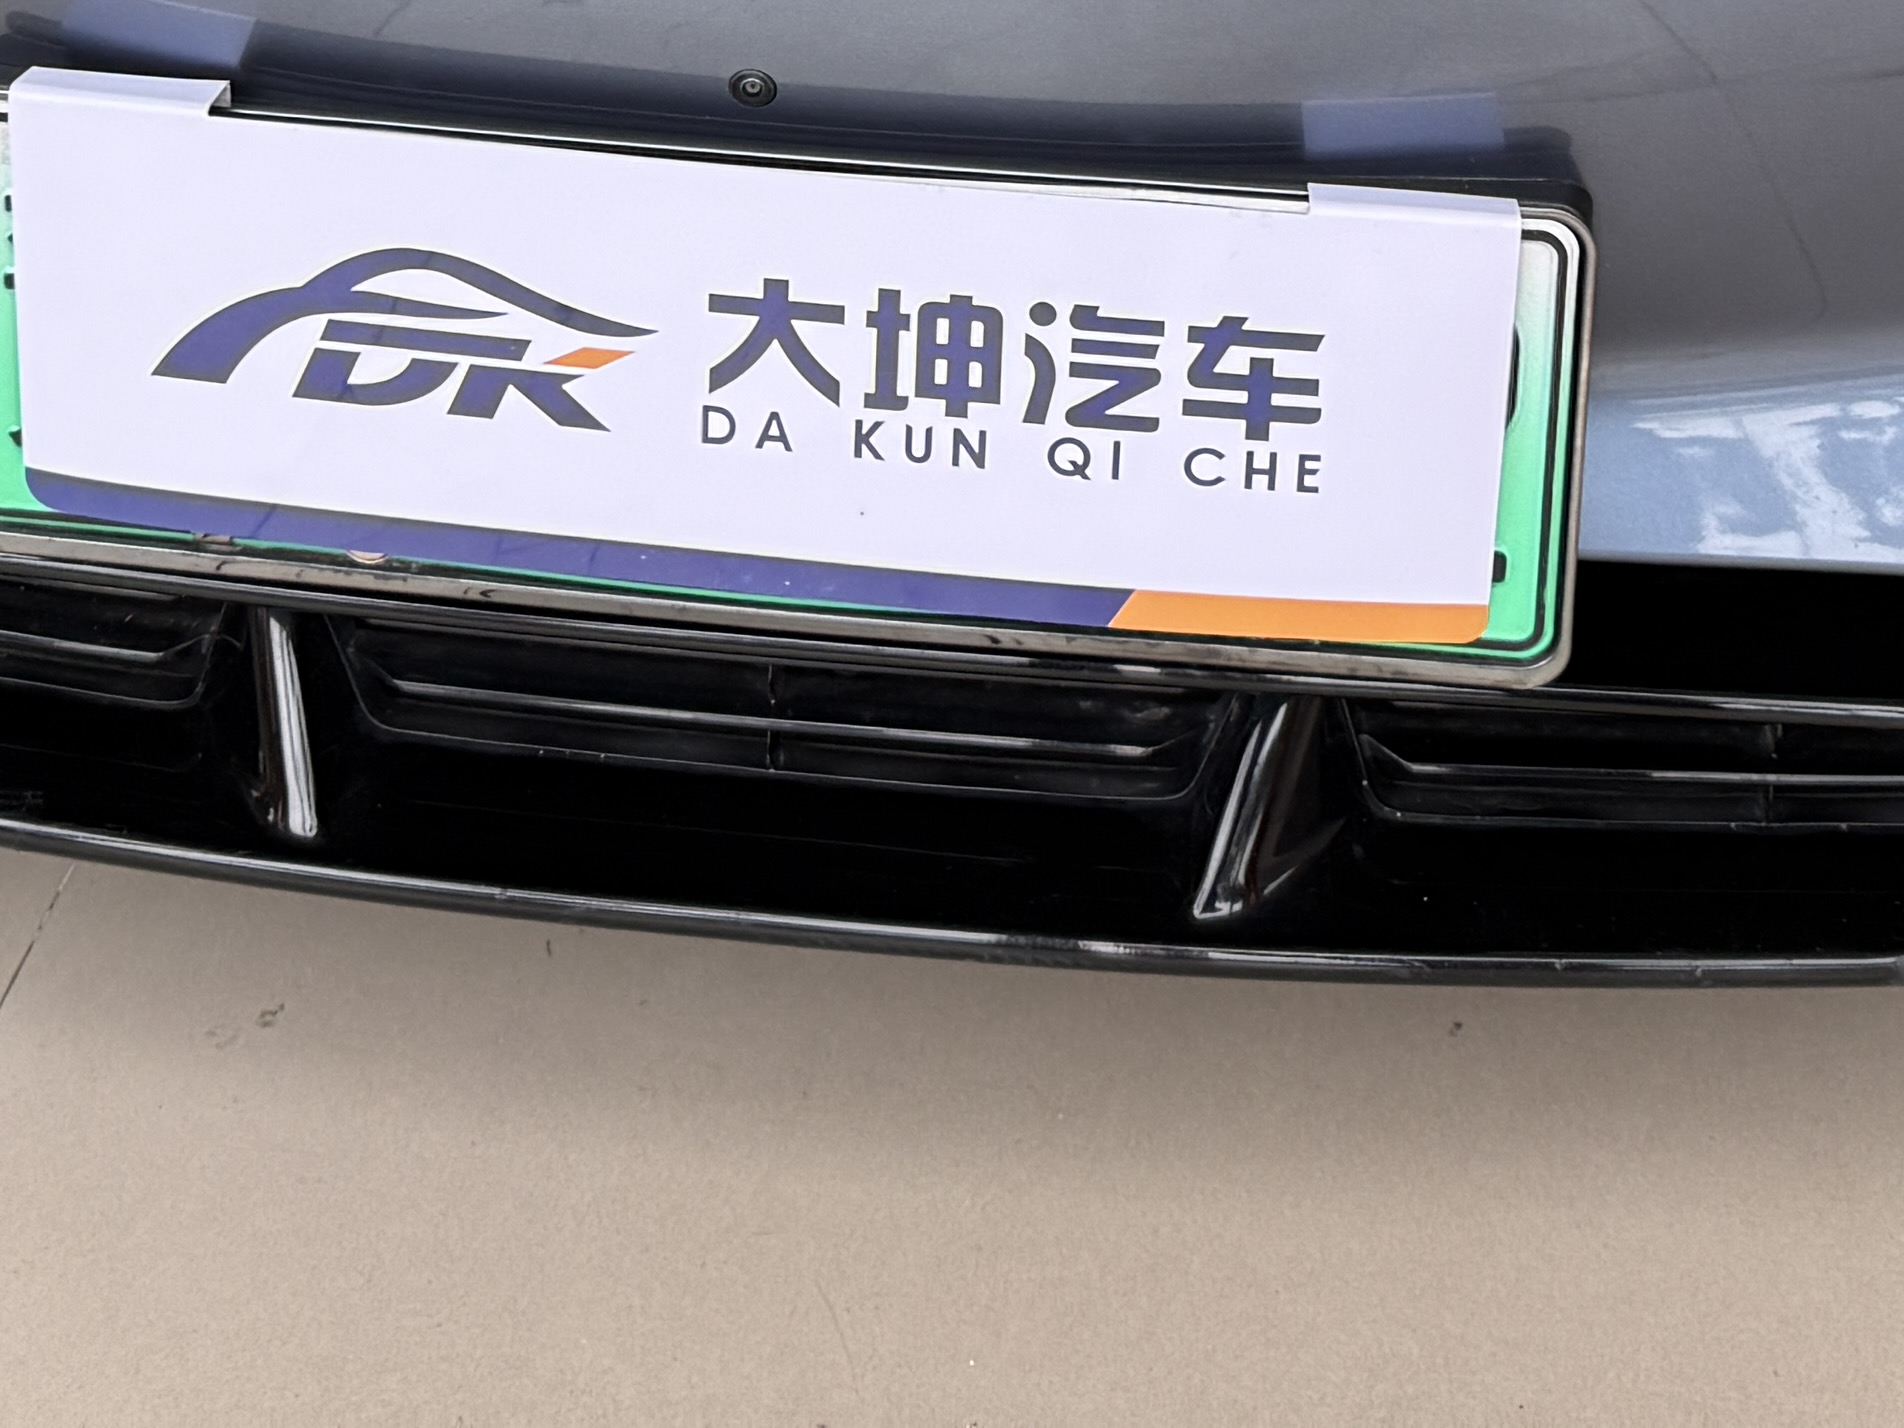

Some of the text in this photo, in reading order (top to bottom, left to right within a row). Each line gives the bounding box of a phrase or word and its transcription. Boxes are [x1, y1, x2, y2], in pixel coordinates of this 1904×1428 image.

[705, 277, 1325, 440] 大坤汽车
[700, 404, 1324, 495] DA KUN QI CHE
